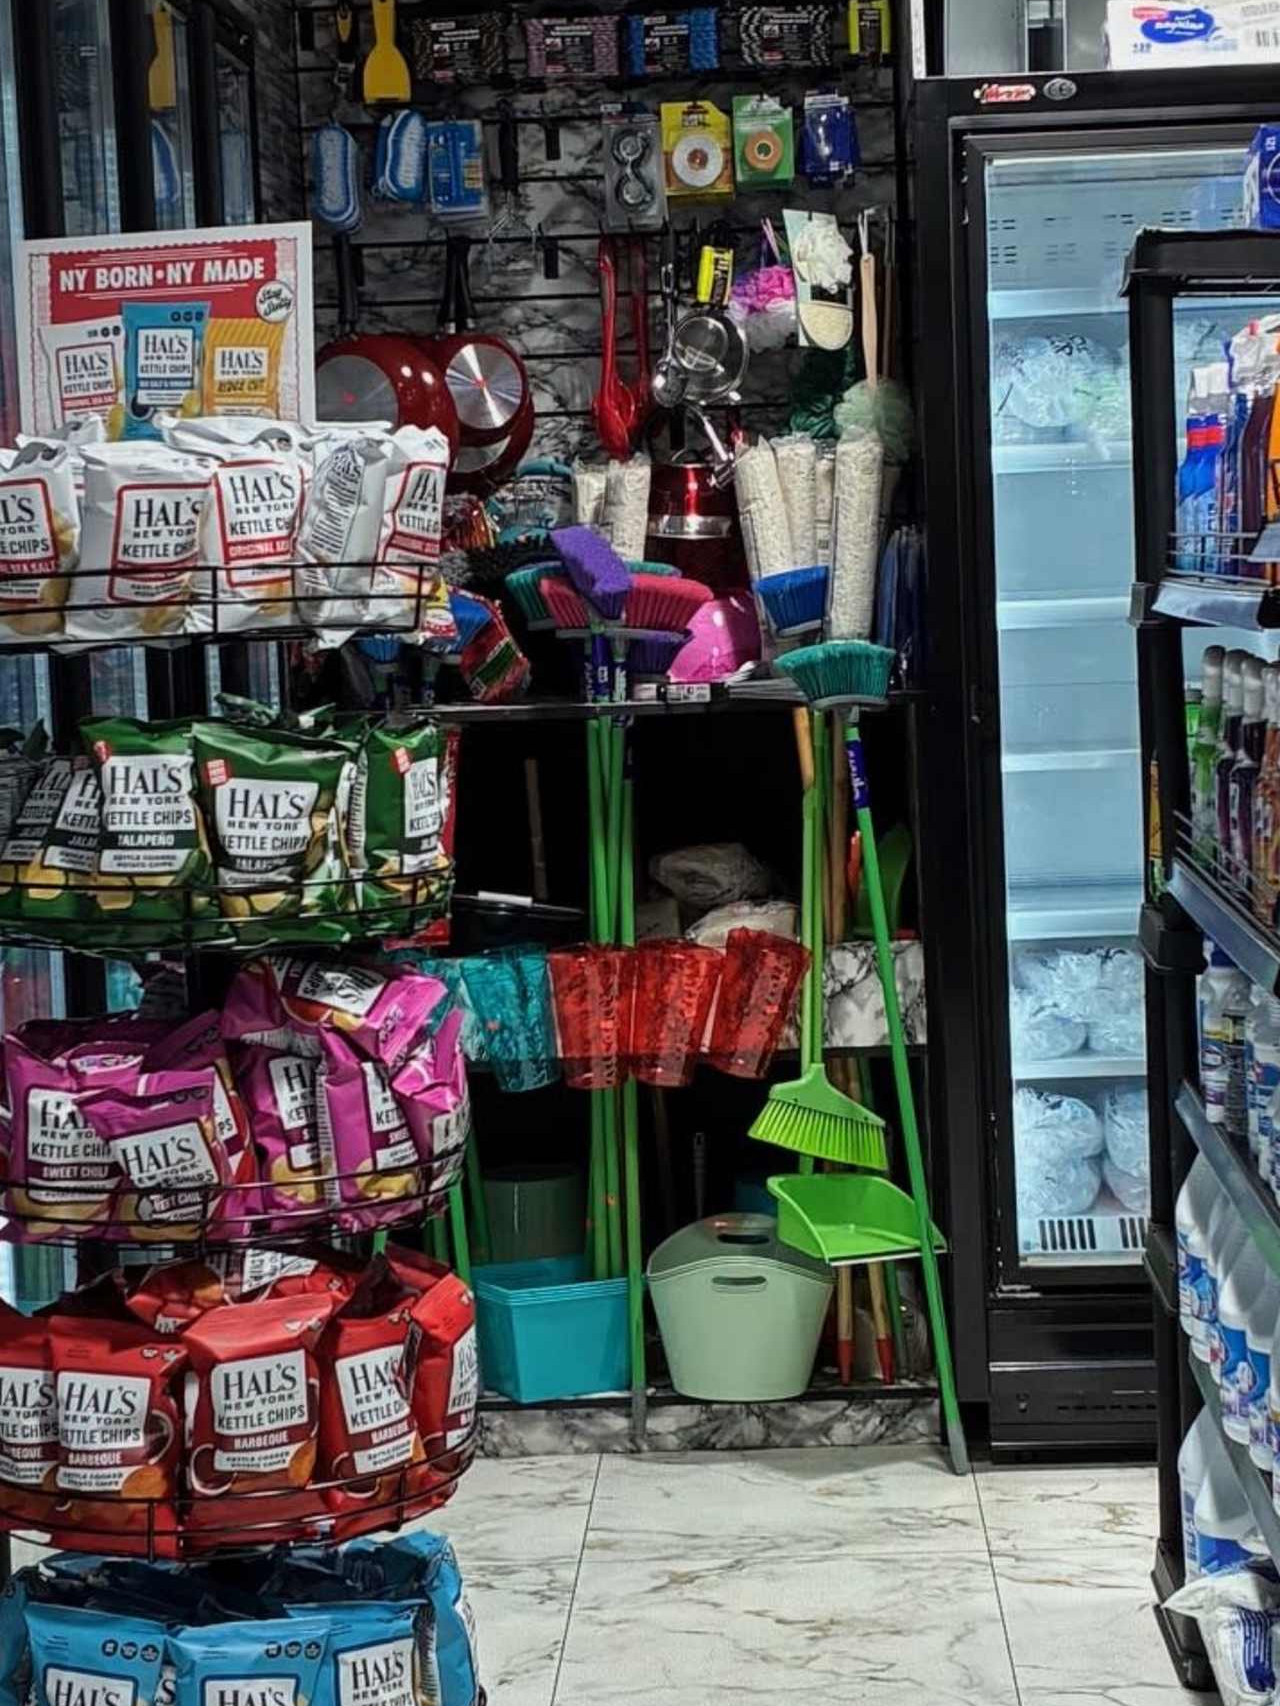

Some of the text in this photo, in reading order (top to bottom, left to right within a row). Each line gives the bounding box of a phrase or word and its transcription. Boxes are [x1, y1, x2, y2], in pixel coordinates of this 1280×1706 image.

[59, 256, 266, 292] NY BORN NY MADE
[144, 334, 189, 354] HAL'S
[140, 363, 169, 375] KETTLE
[221, 350, 264, 370] HAL'S
[230, 470, 296, 505] HAL'S
[229, 517, 274, 536] KETTLE
[10, 537, 50, 555] CHIPS
[122, 542, 169, 559] KETTLE
[110, 763, 183, 794] HAL'S
[146, 794, 182, 806] YORK
[229, 787, 306, 820] HAL'S
[153, 809, 193, 825] CHIPS
[31, 1142, 81, 1159] KETTLE
[120, 1136, 197, 1179] HAL'S
[42, 1165, 78, 1179] SWEET
[222, 1362, 298, 1401] HAL'S
[64, 1381, 138, 1418] HAL'S
[260, 1393, 296, 1406] YORK
[217, 1403, 306, 1432] KETTLE CHIPS
[350, 1406, 393, 1428] KETTLE
[21, 1422, 60, 1439] CHIPS
[100, 1427, 142, 1444] CHIPS
[233, 1429, 289, 1450] BARBEQUE
[67, 1450, 123, 1466] BARBEQUE
[351, 1649, 405, 1691] HAL'S
